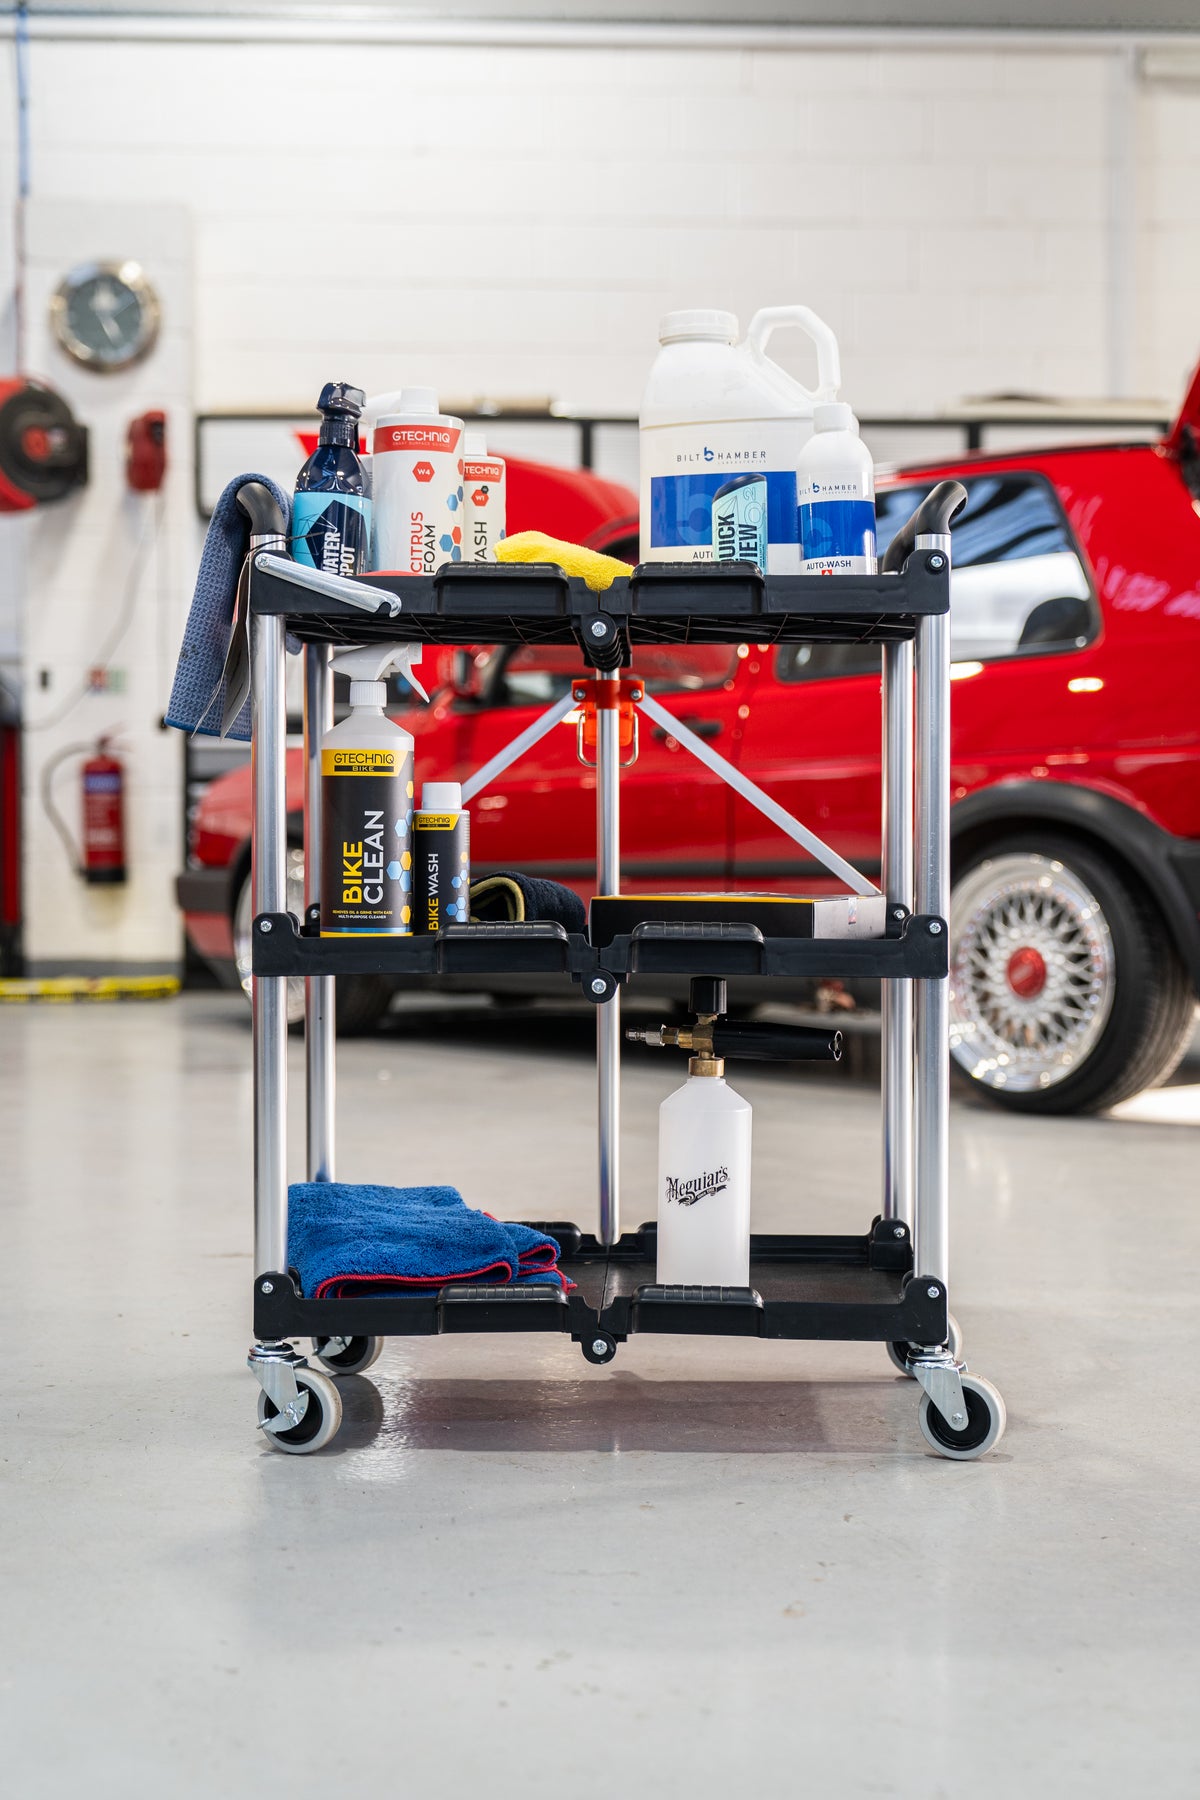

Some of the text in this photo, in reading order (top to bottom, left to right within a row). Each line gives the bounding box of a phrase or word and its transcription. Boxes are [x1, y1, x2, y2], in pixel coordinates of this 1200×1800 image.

[392, 430, 450, 443] GTECHNIQ
[463, 465, 499, 476] TECHNIQ
[676, 453, 700, 463] BILT
[717, 451, 766, 460] HAMBER
[822, 484, 857, 492] HAMBER
[410, 511, 424, 573] CITRUS
[423, 524, 436, 573] FOAM
[474, 521, 487, 562] ASH
[692, 551, 713, 559] AUT
[718, 512, 736, 561] UICK
[806, 560, 852, 571] AUTO-WASH
[334, 753, 395, 764] GTECHNIQ
[342, 841, 363, 904] BIKE
[363, 810, 384, 905] CLEAN
[428, 853, 439, 931] BIKE WASH
[666, 1166, 729, 1203] Meguiar's
